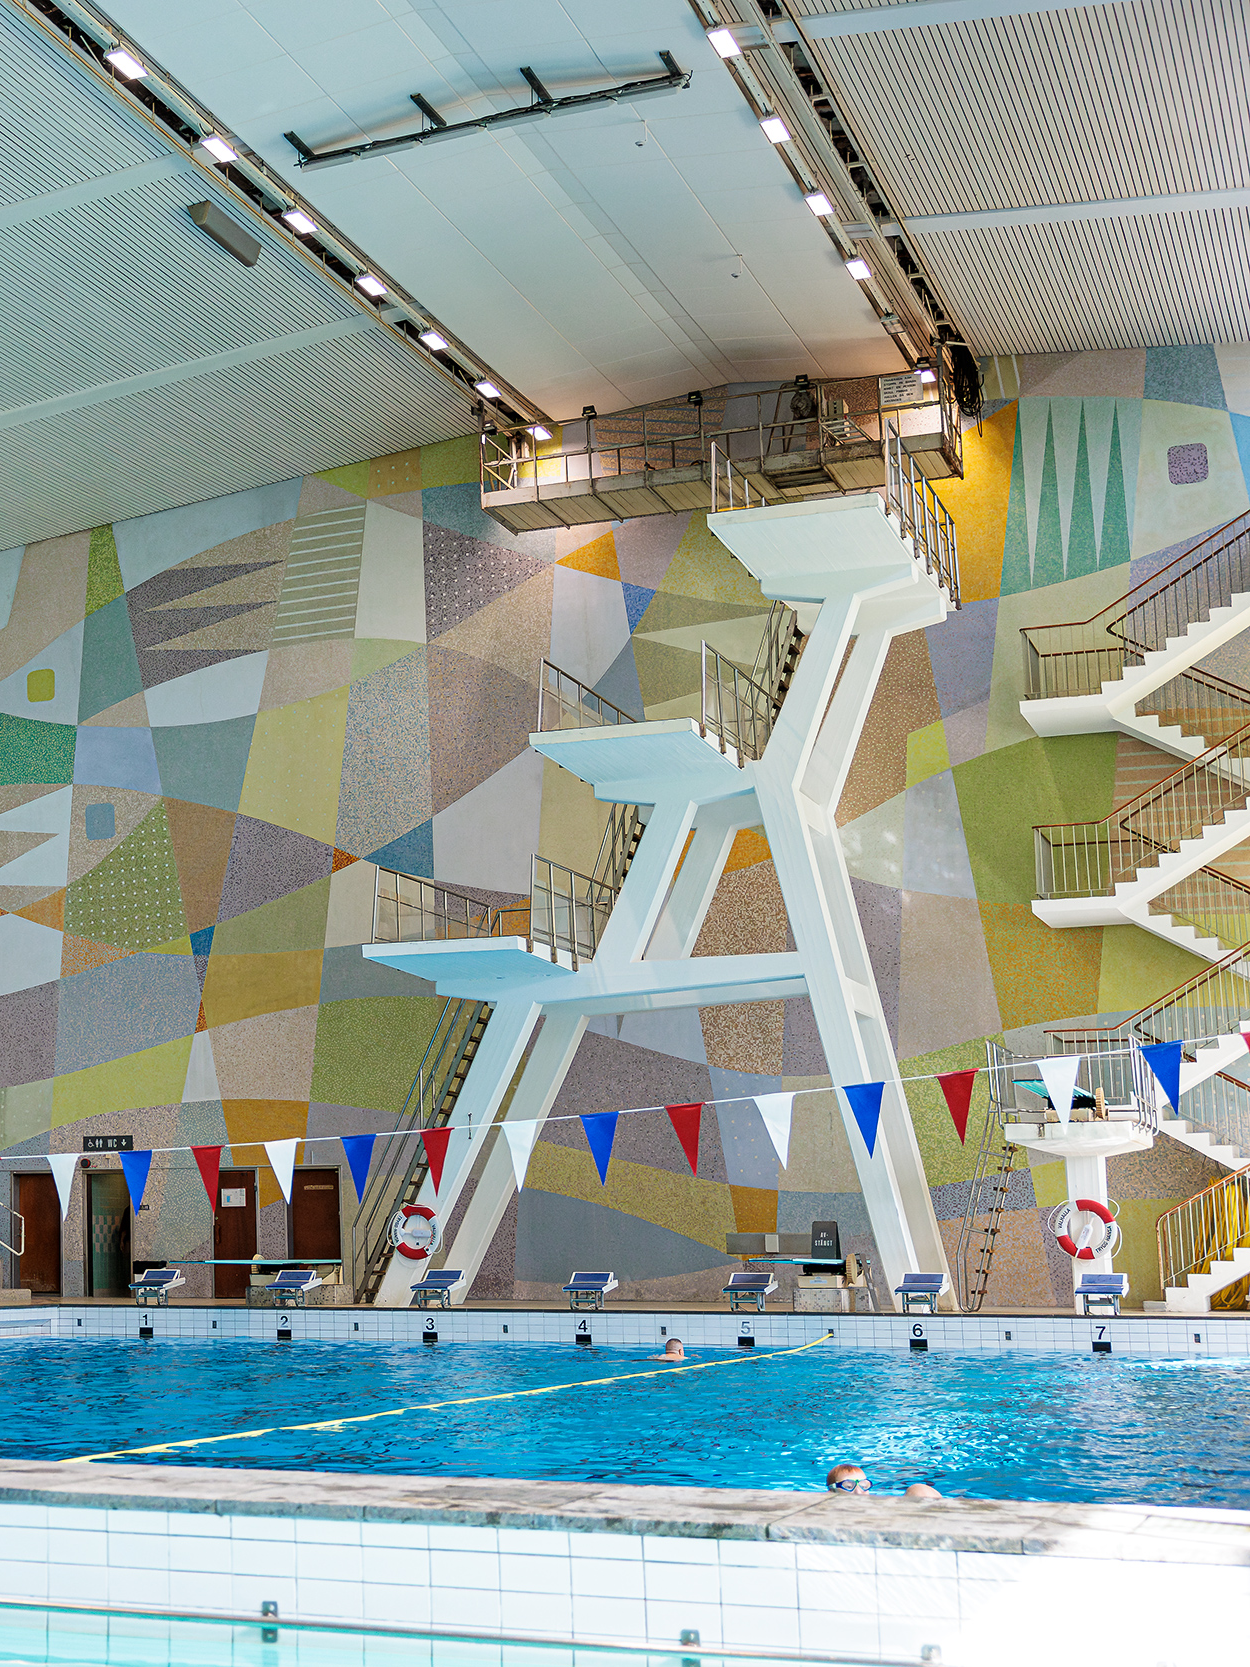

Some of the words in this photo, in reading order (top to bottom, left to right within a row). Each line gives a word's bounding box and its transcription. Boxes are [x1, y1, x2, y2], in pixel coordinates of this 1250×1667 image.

[107, 1138, 118, 1148] WC
[142, 1314, 148, 1326] 1
[280, 1316, 289, 1328] 2
[426, 1318, 434, 1330] 3
[578, 1320, 588, 1332] 4
[741, 1321, 750, 1334] 5
[912, 1324, 924, 1338] 6
[1096, 1326, 1106, 1340] 7
